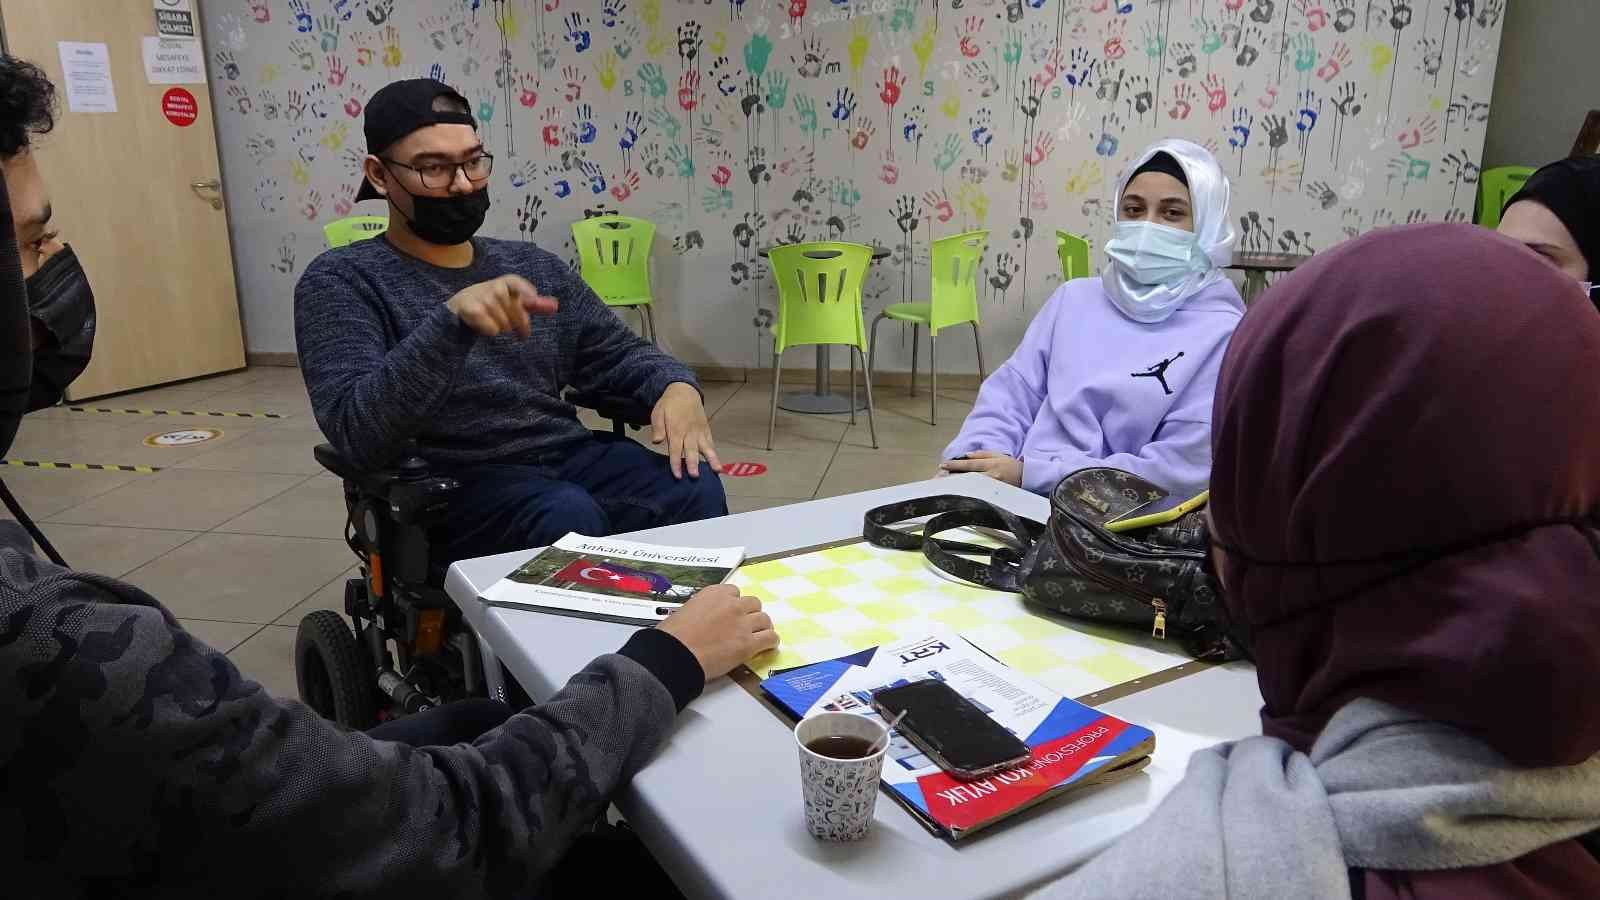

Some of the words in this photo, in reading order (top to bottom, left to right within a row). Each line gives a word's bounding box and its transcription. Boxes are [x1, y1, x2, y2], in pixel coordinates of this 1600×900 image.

[576, 542, 628, 555] Ankara
[899, 641, 951, 665] KRT
[1030, 726, 1110, 771] PROFESYONE
